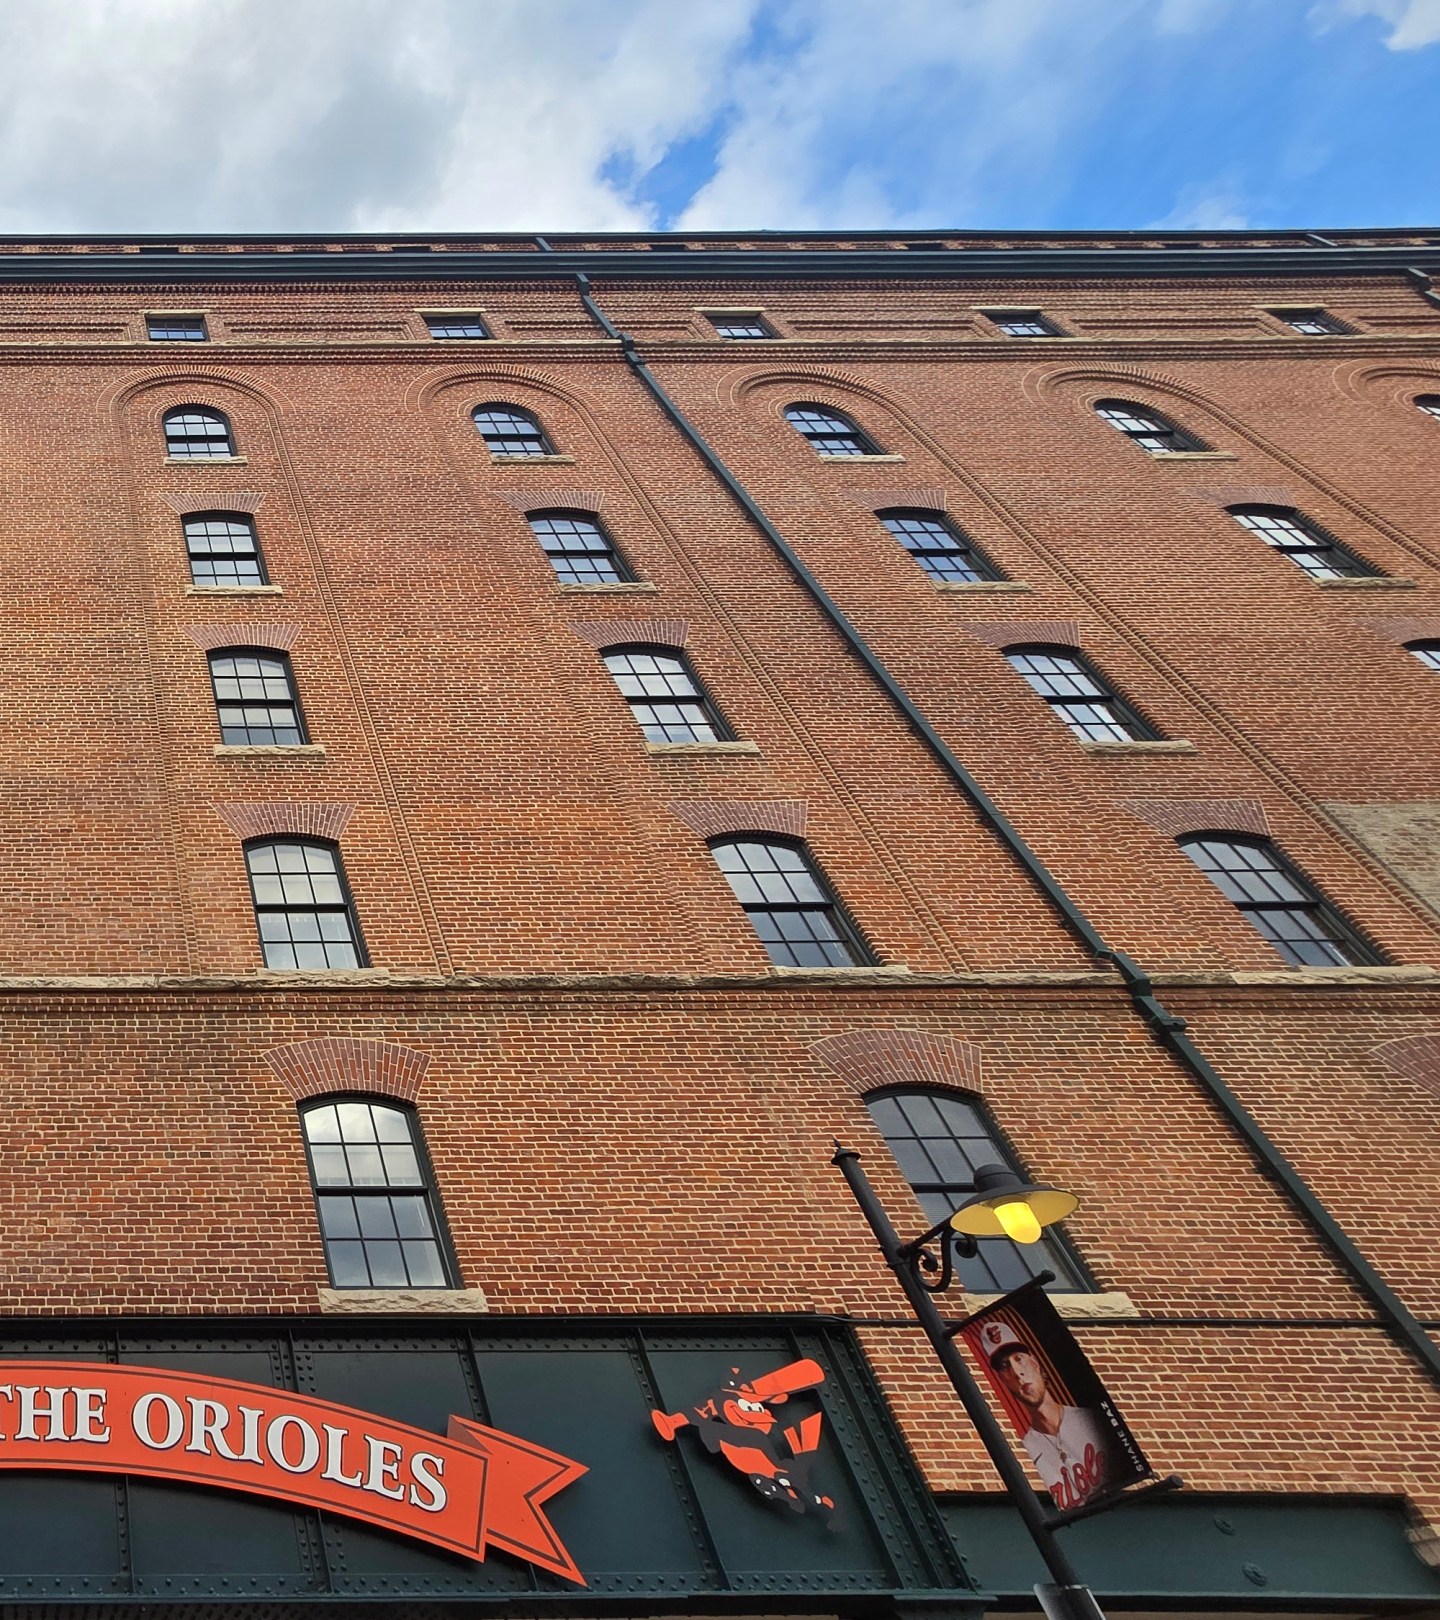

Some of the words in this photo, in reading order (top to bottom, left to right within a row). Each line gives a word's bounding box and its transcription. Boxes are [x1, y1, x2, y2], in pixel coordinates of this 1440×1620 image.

[1100, 1400, 1119, 1427] BAZ
[131, 1392, 448, 1513] ORIOLES
[1117, 1430, 1144, 1472] SHANE
